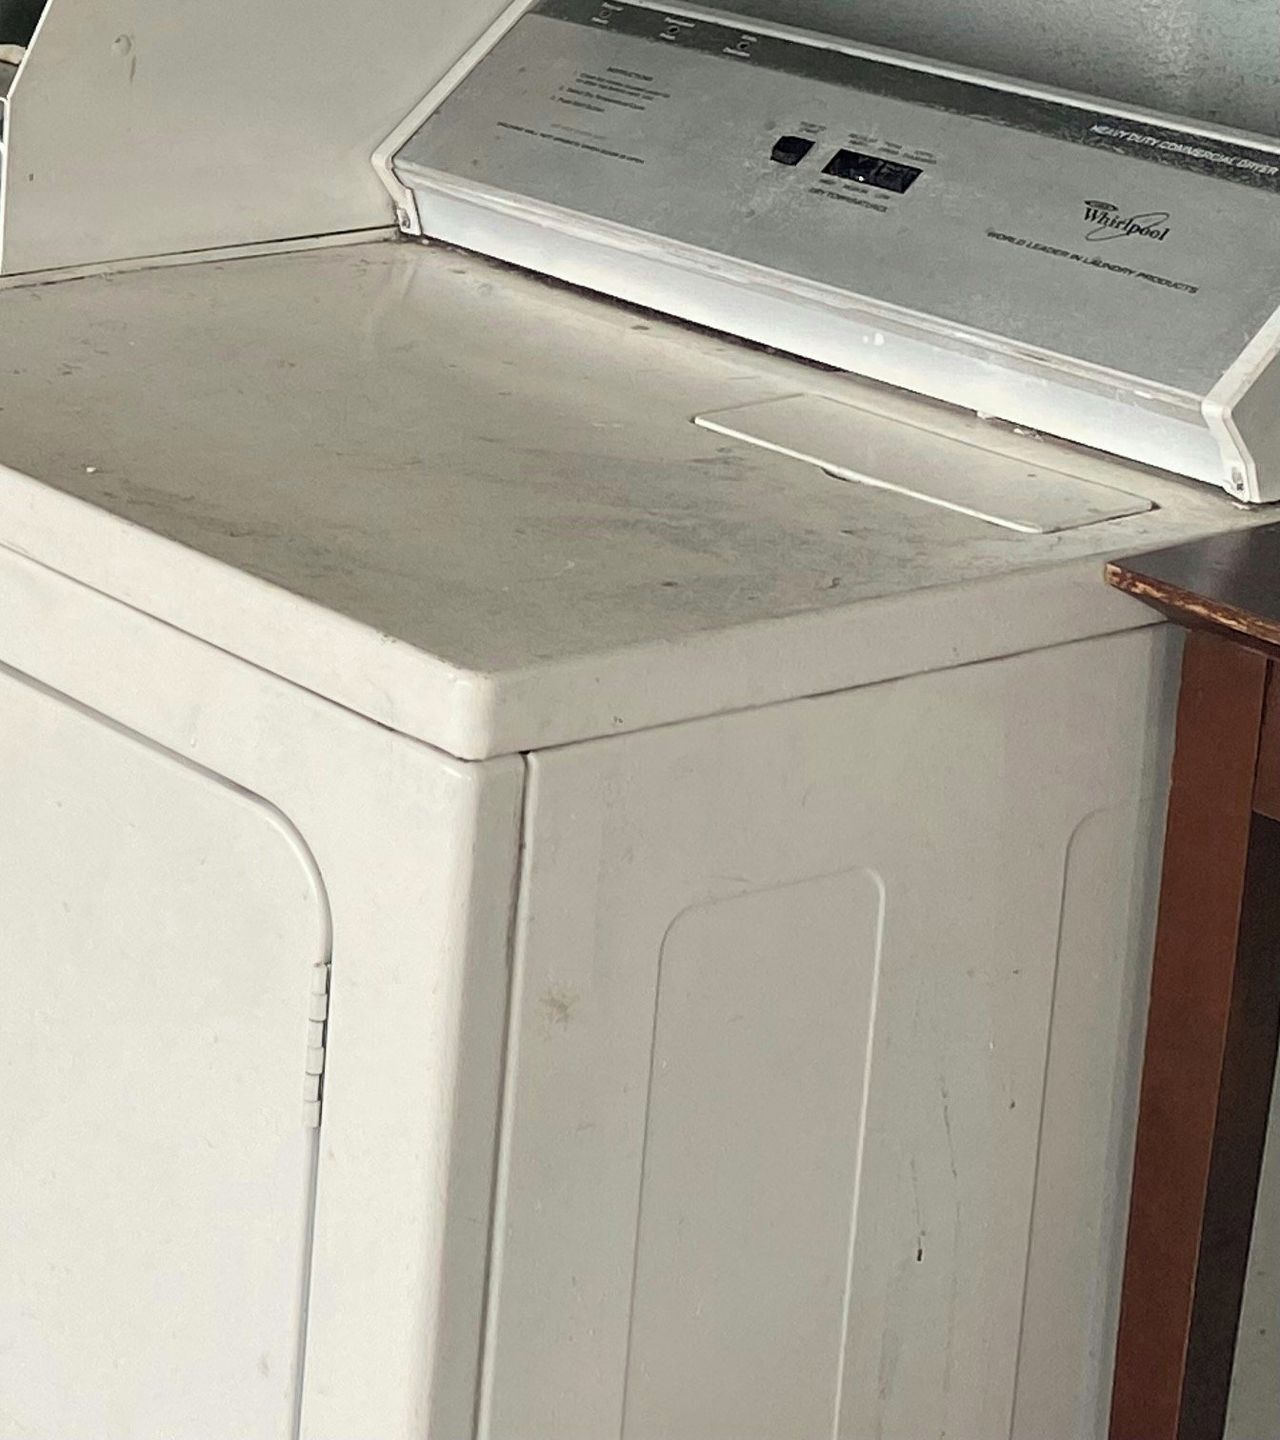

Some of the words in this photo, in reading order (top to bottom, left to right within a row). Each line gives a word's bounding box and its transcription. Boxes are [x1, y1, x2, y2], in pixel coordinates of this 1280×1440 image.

[1090, 125, 1128, 138] HEAVY
[1126, 132, 1161, 147] DUTY
[1158, 141, 1238, 166] COMMERCIAL
[1236, 158, 1280, 176] DRYER
[1083, 206, 1171, 242] Whirlpool
[986, 230, 1026, 247] WORLD
[1025, 240, 1070, 258] LEADER
[1069, 252, 1083, 262] IN
[1082, 257, 1136, 277] LAUNDRY
[1135, 271, 1200, 295] PRODUCTS
